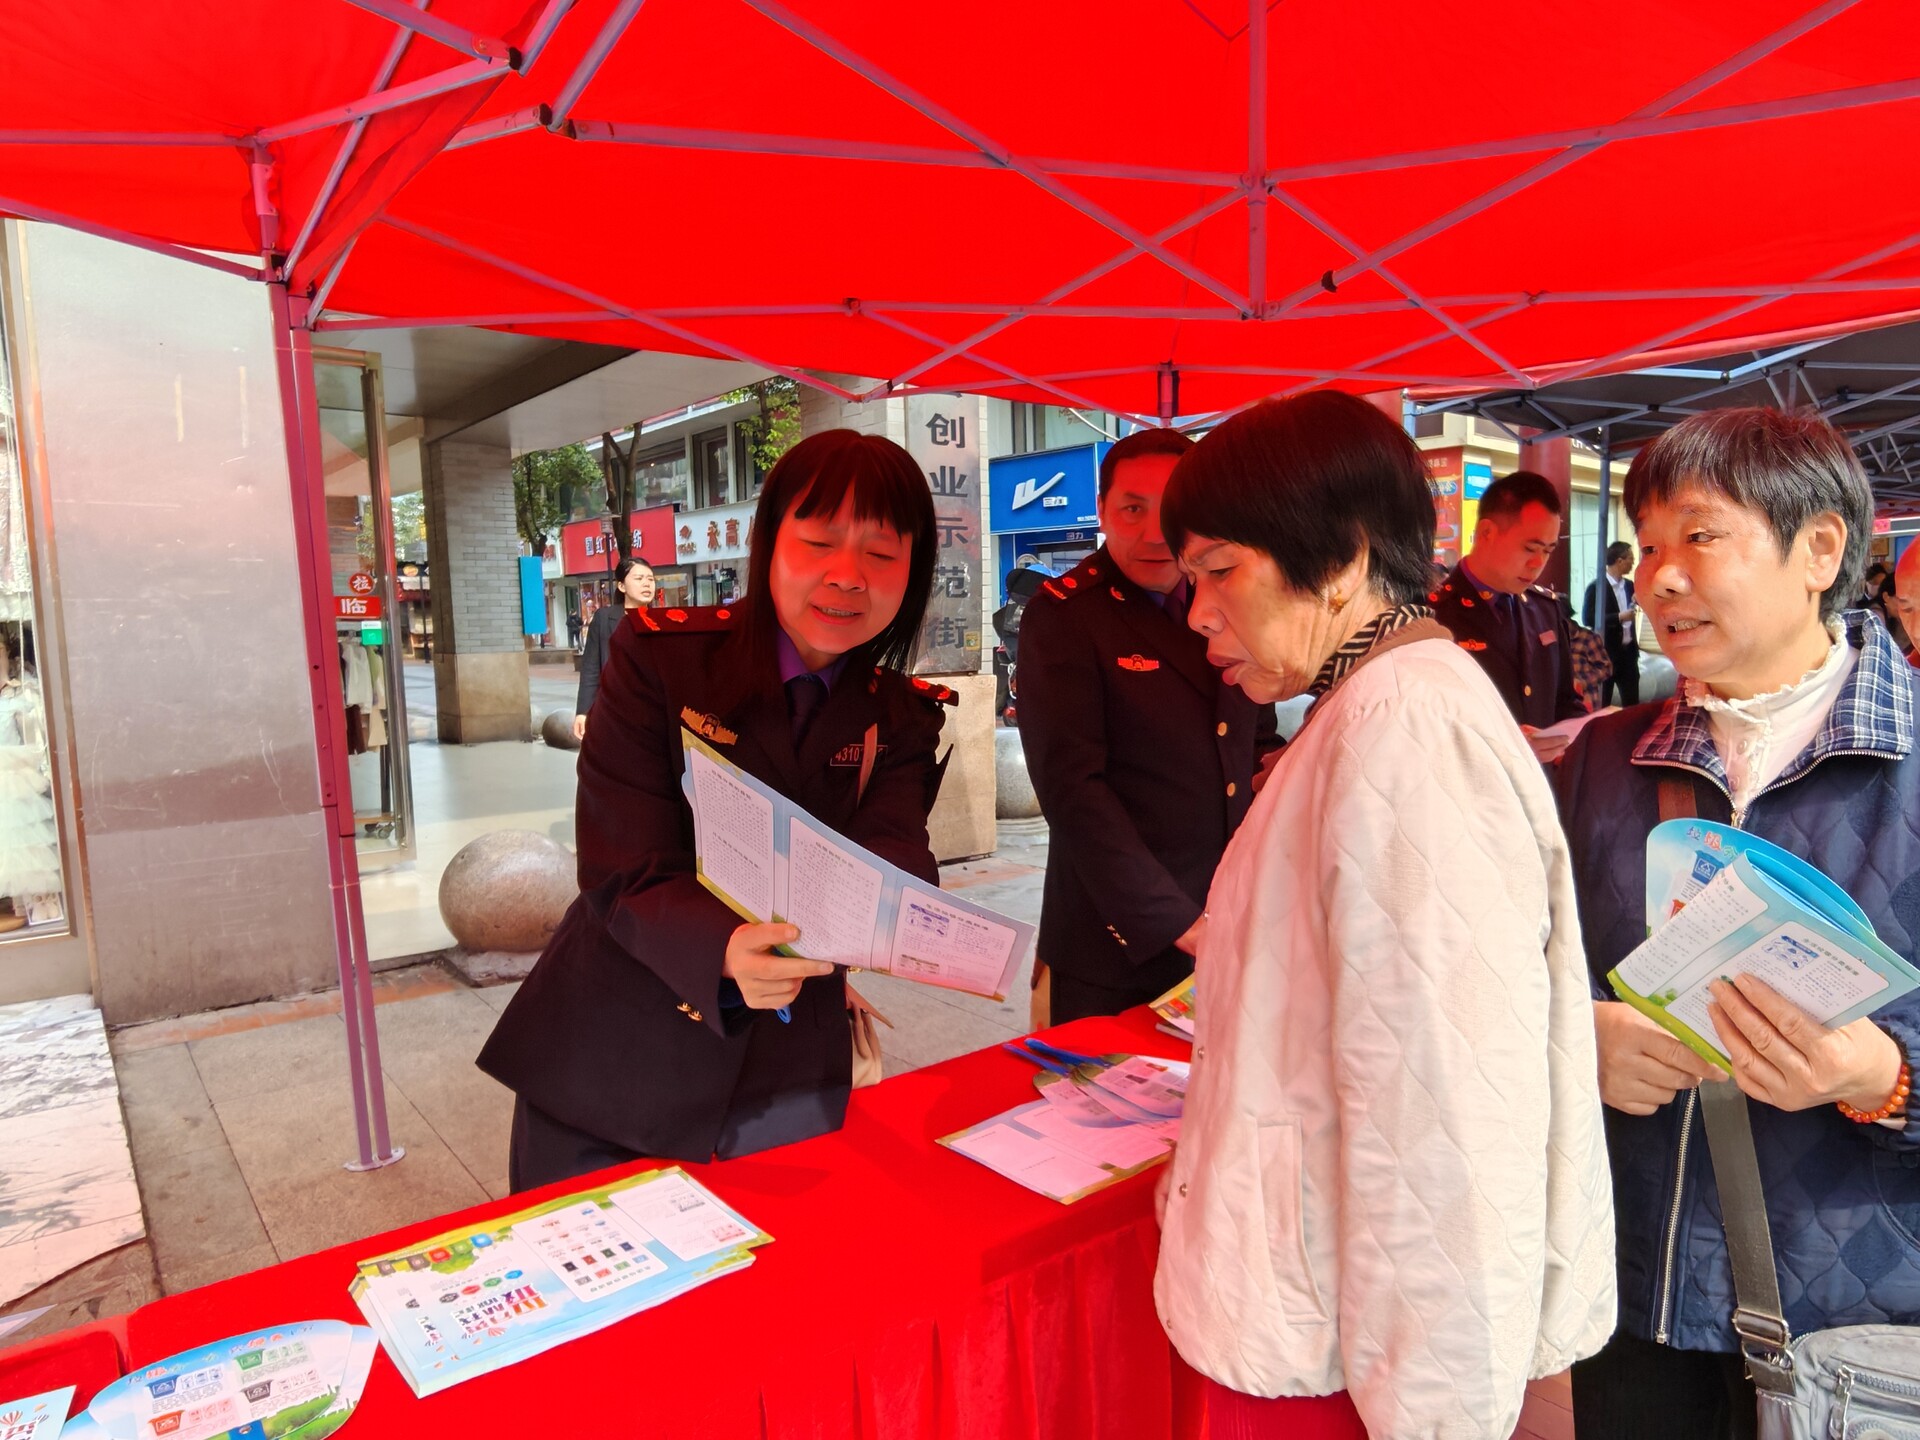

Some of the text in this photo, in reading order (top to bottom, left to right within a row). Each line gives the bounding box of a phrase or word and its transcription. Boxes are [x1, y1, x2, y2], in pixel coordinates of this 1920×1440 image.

[925, 391, 969, 650] 创业示范街
